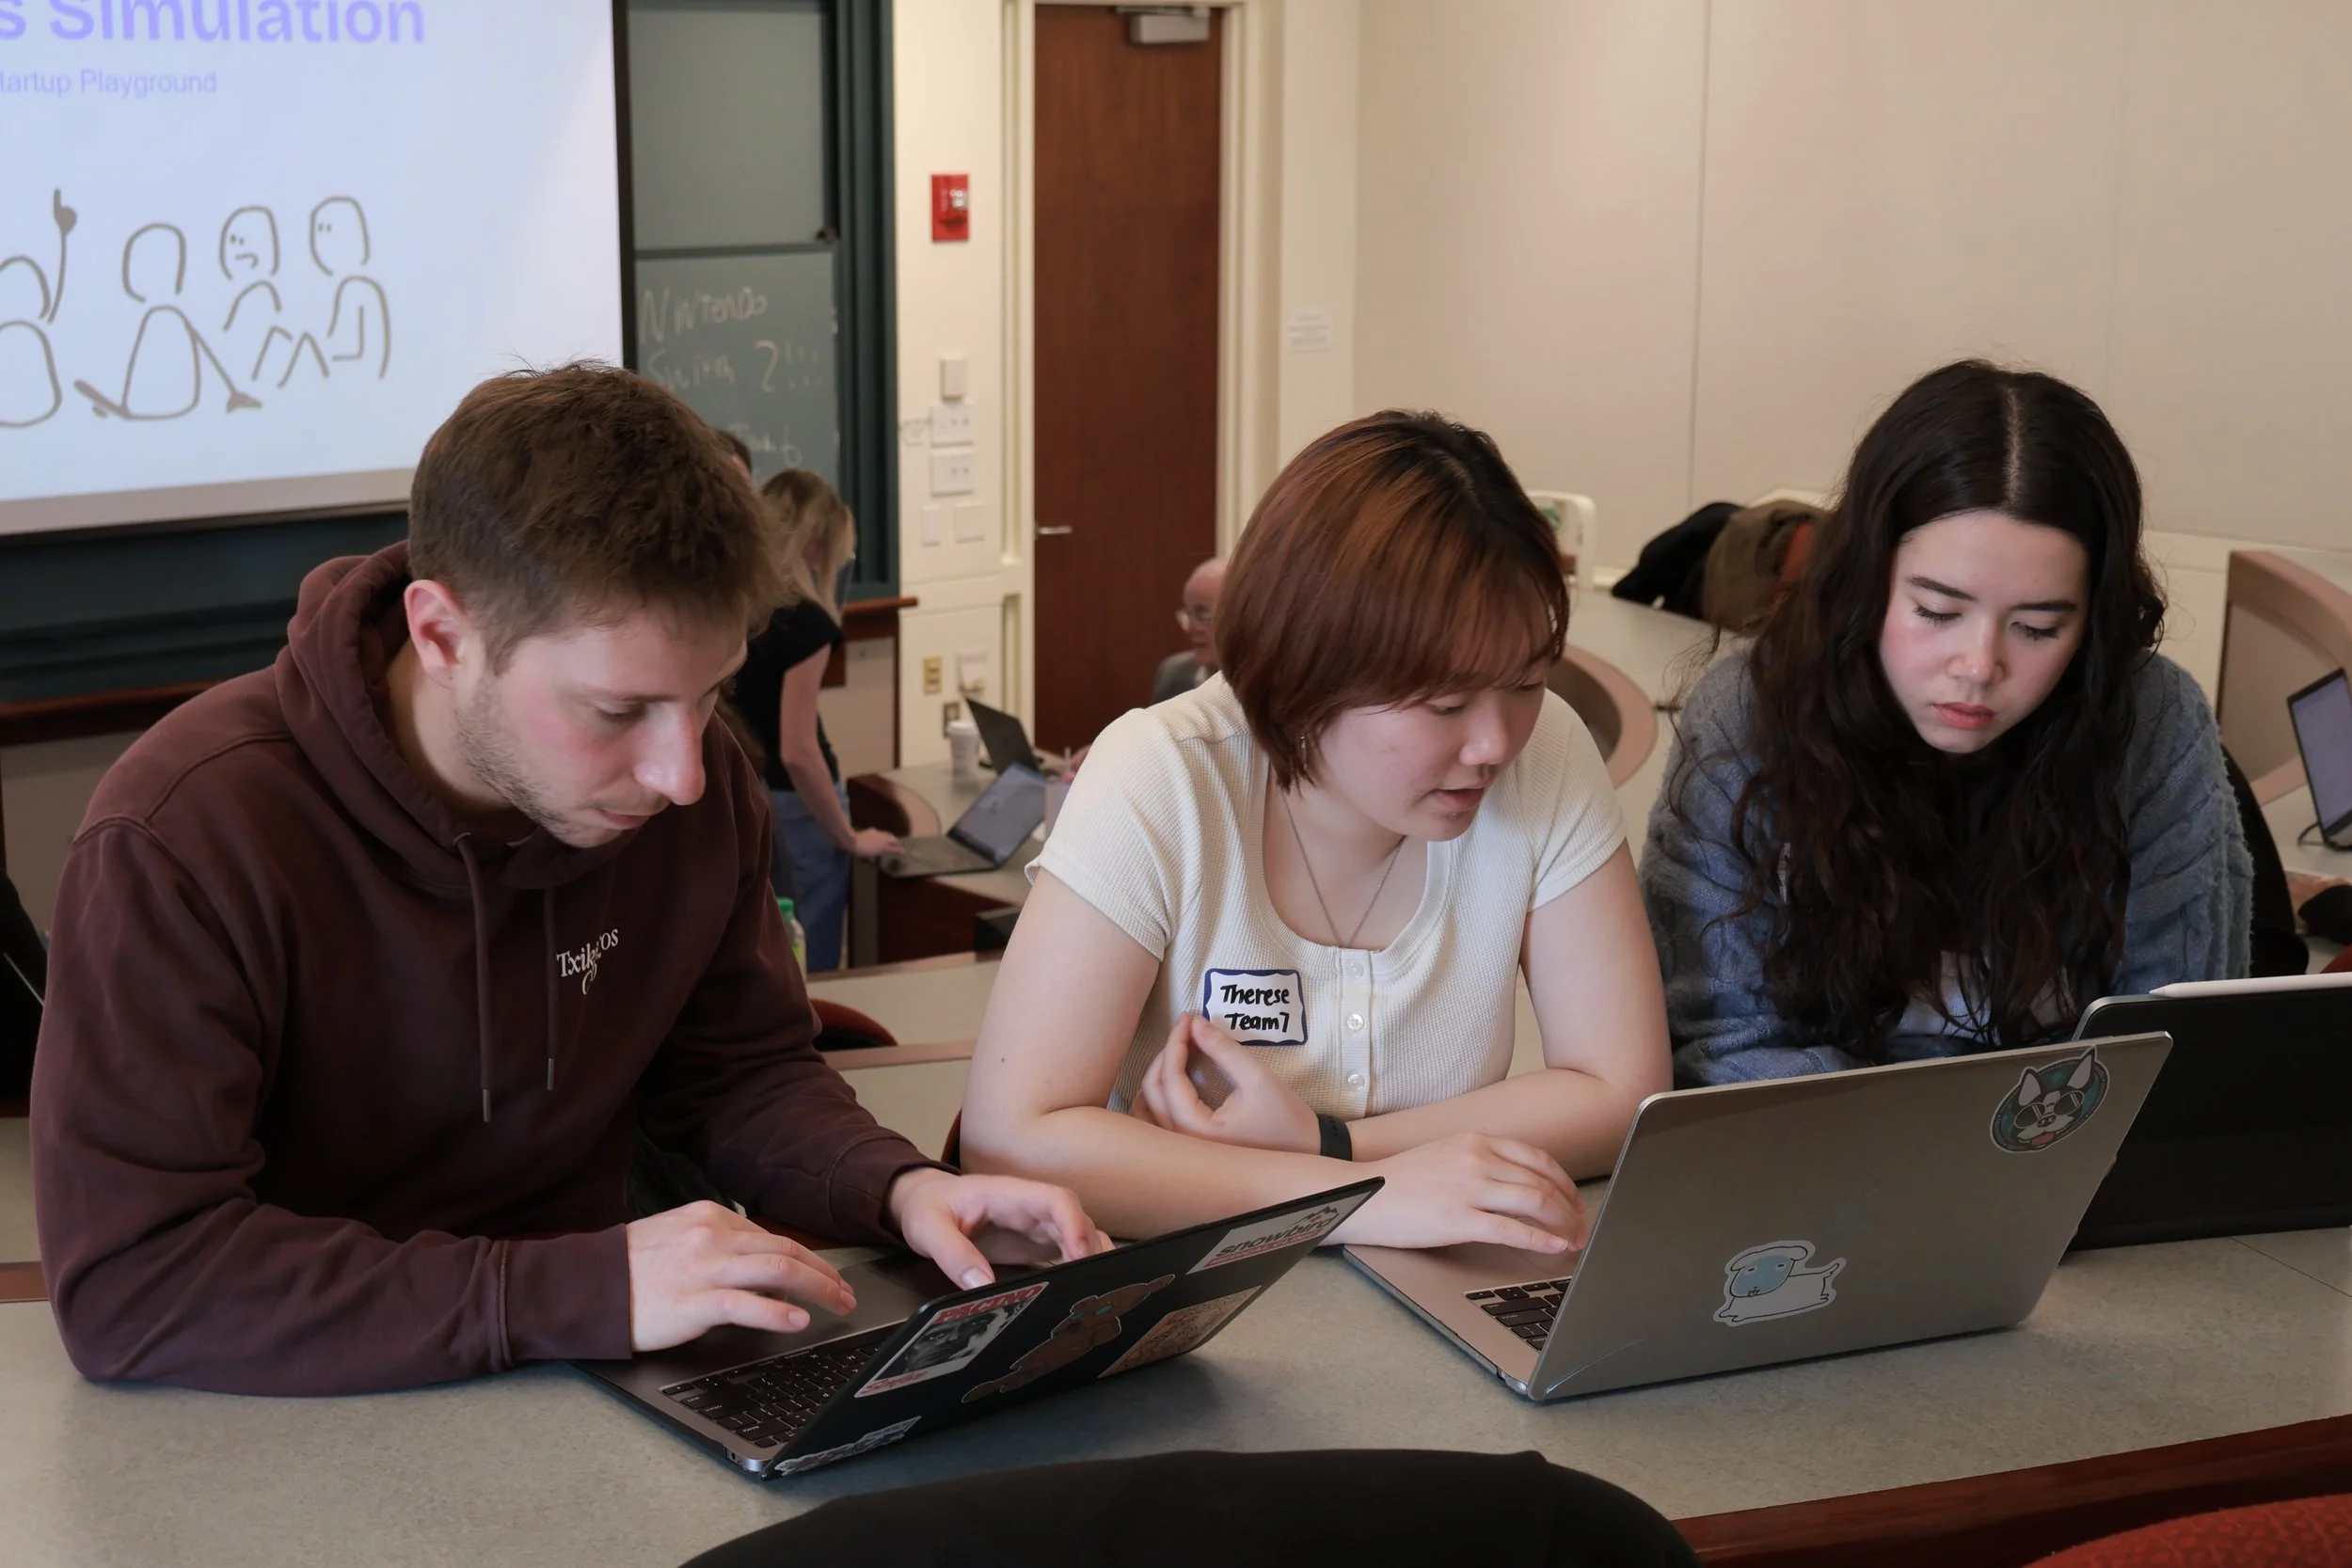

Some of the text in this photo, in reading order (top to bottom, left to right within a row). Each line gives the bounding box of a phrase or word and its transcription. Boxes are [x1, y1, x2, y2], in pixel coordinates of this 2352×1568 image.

[50, 0, 424, 44] Simulation
[80, 69, 217, 100] Playground
[1220, 984, 1290, 1006] Therese
[1216, 1212, 1340, 1258] snowbird
[932, 1285, 1043, 1325] PACINO
